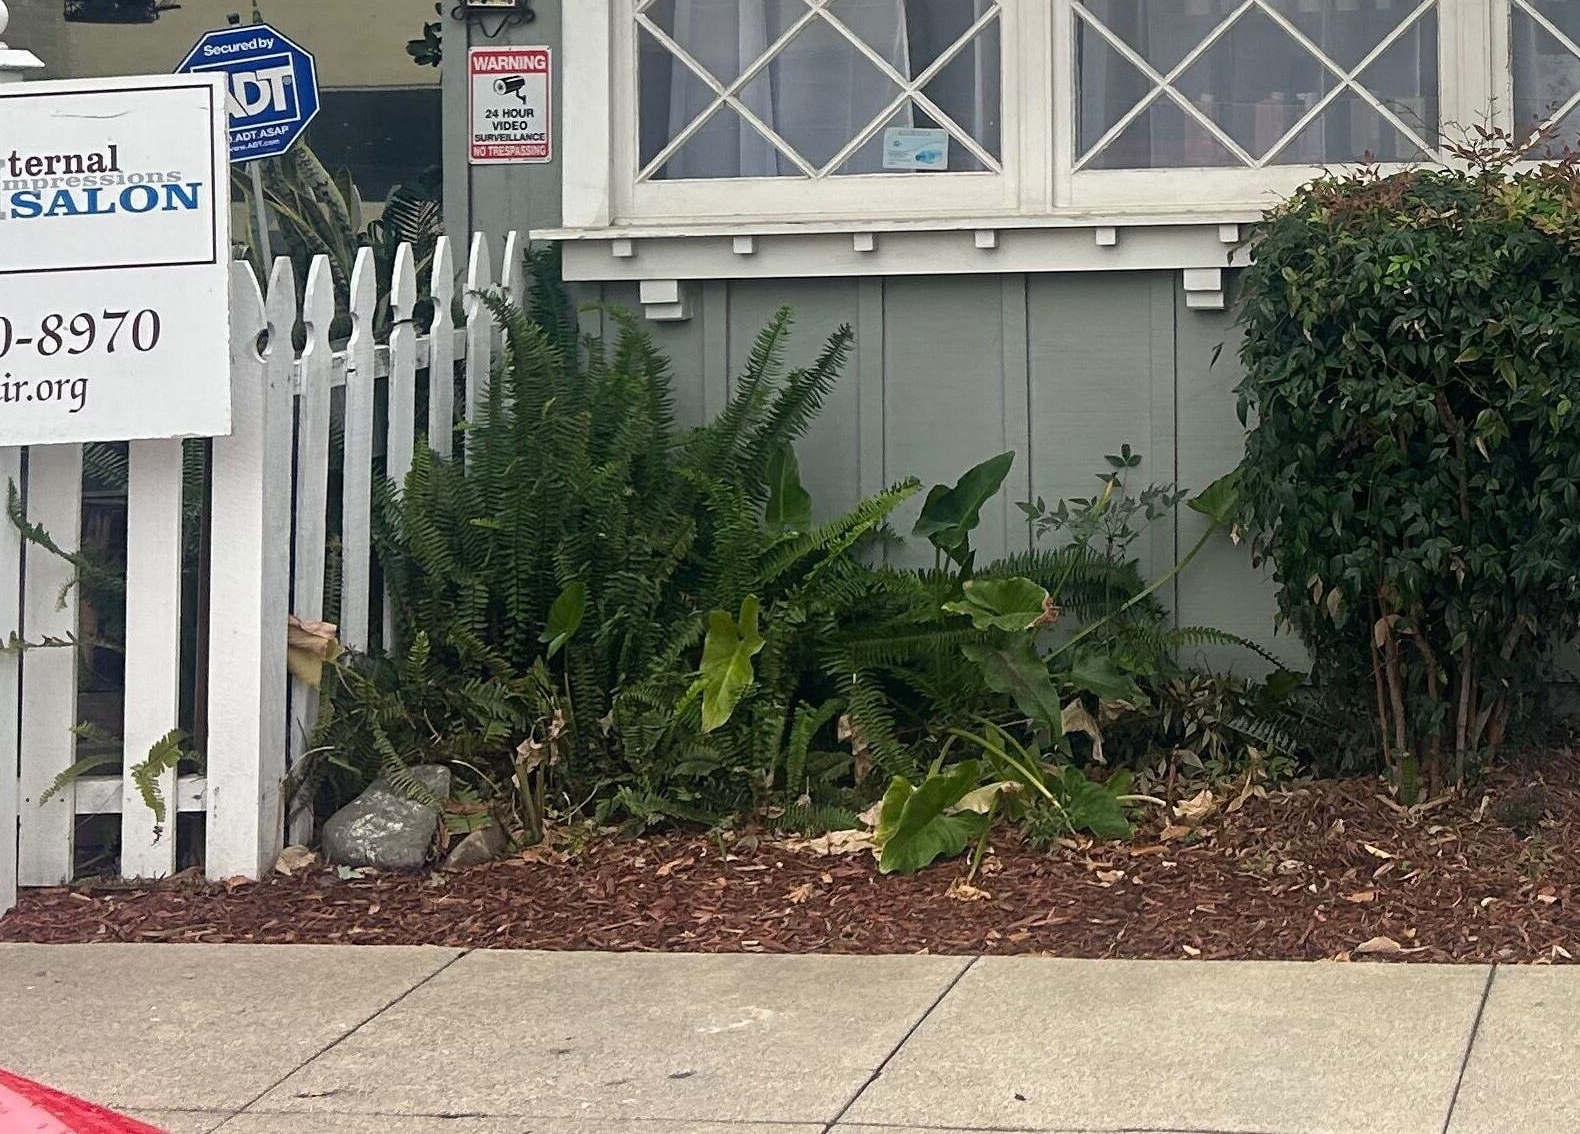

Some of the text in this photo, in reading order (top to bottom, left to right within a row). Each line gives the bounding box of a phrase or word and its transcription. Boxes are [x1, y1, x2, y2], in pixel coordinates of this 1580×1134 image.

[203, 37, 275, 57] Secured by
[473, 55, 546, 71] WARNING
[485, 108, 534, 119] 24 HOUR
[492, 121, 528, 131] VIDEO
[475, 133, 545, 142] SURVEILLANCE
[473, 146, 547, 156] NO TRESPASSING
[2, 170, 182, 193] mpressions
[10, 182, 203, 219] SALON
[0, 372, 89, 413] ir.org
